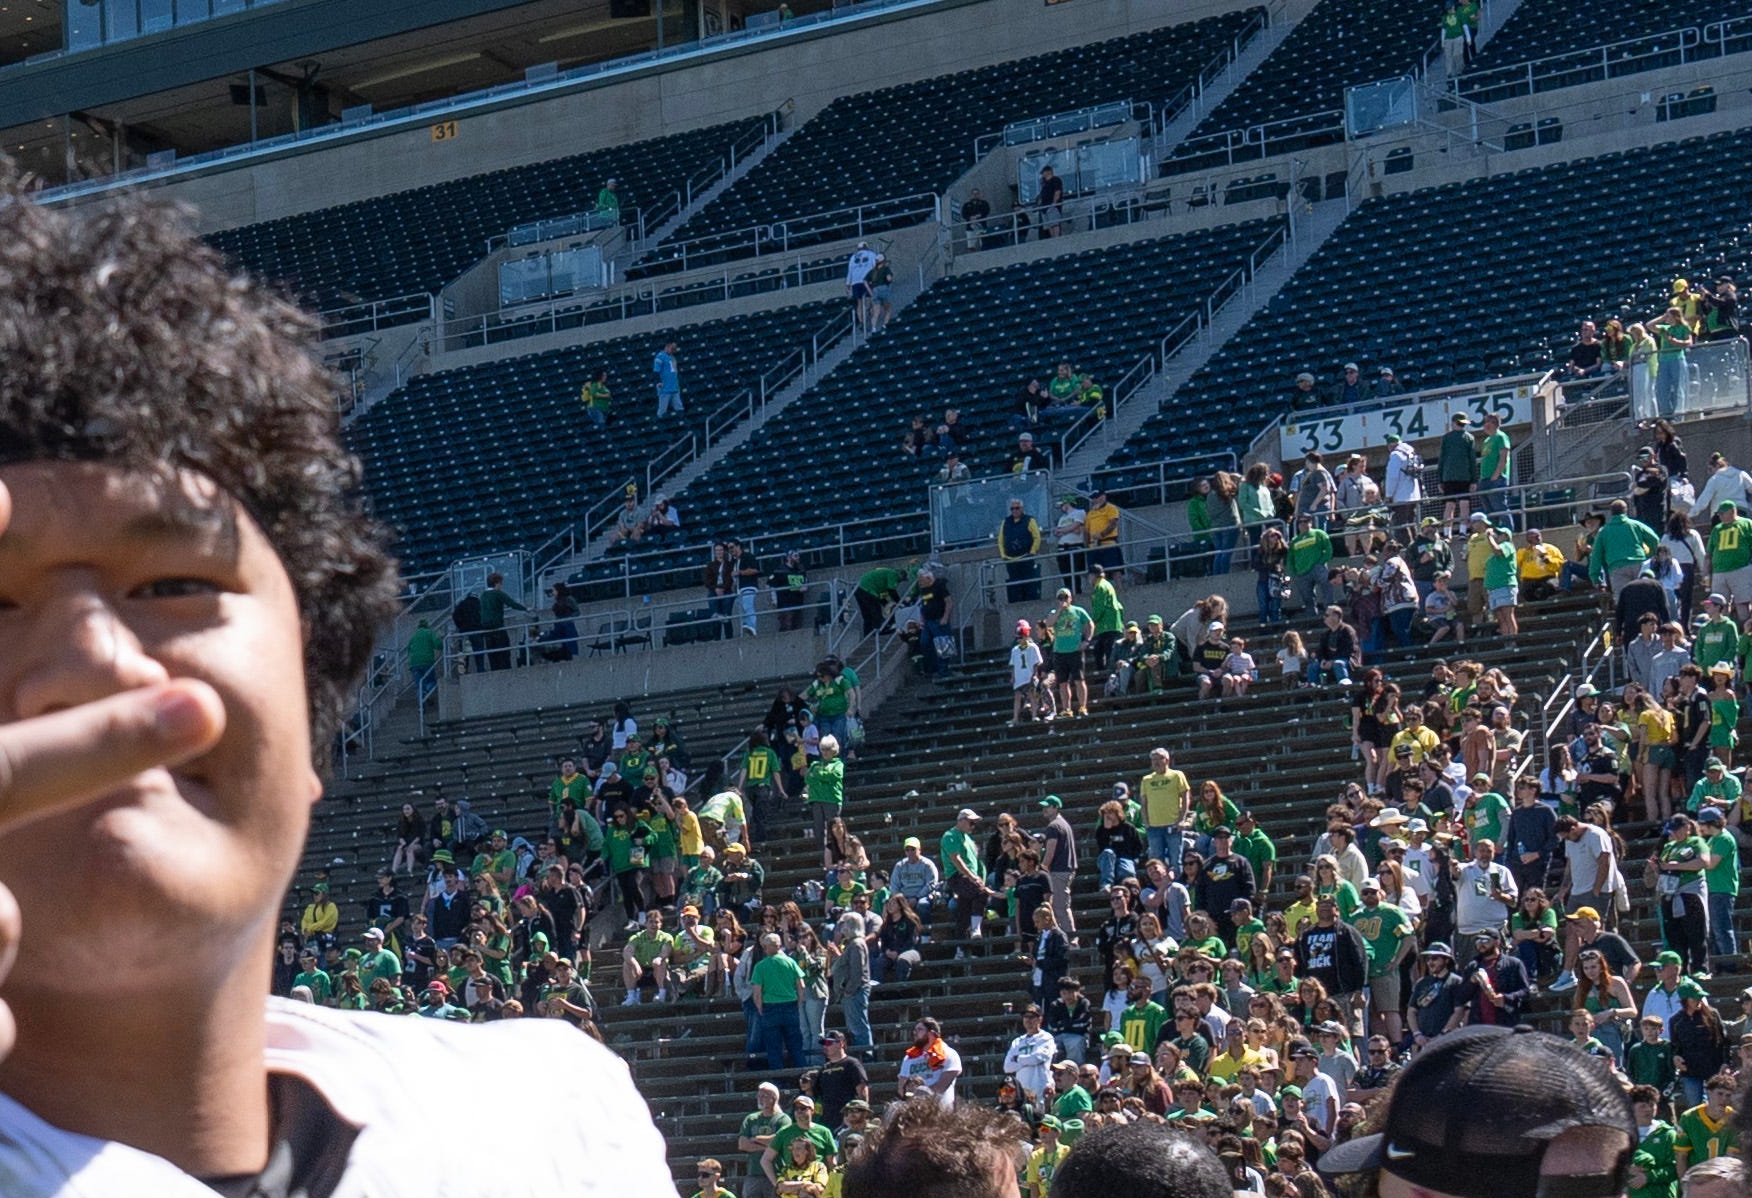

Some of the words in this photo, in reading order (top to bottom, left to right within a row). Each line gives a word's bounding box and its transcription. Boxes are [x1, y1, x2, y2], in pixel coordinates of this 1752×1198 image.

[436, 122, 455, 139] 31
[1299, 418, 1344, 454] 33
[1382, 406, 1429, 440] 34
[1467, 392, 1514, 428] 35
[1719, 528, 1738, 550] 10
[1021, 653, 1027, 668] 1
[749, 756, 768, 779] 10
[1125, 1019, 1146, 1052] 10
[1707, 1137, 1720, 1158] 1
